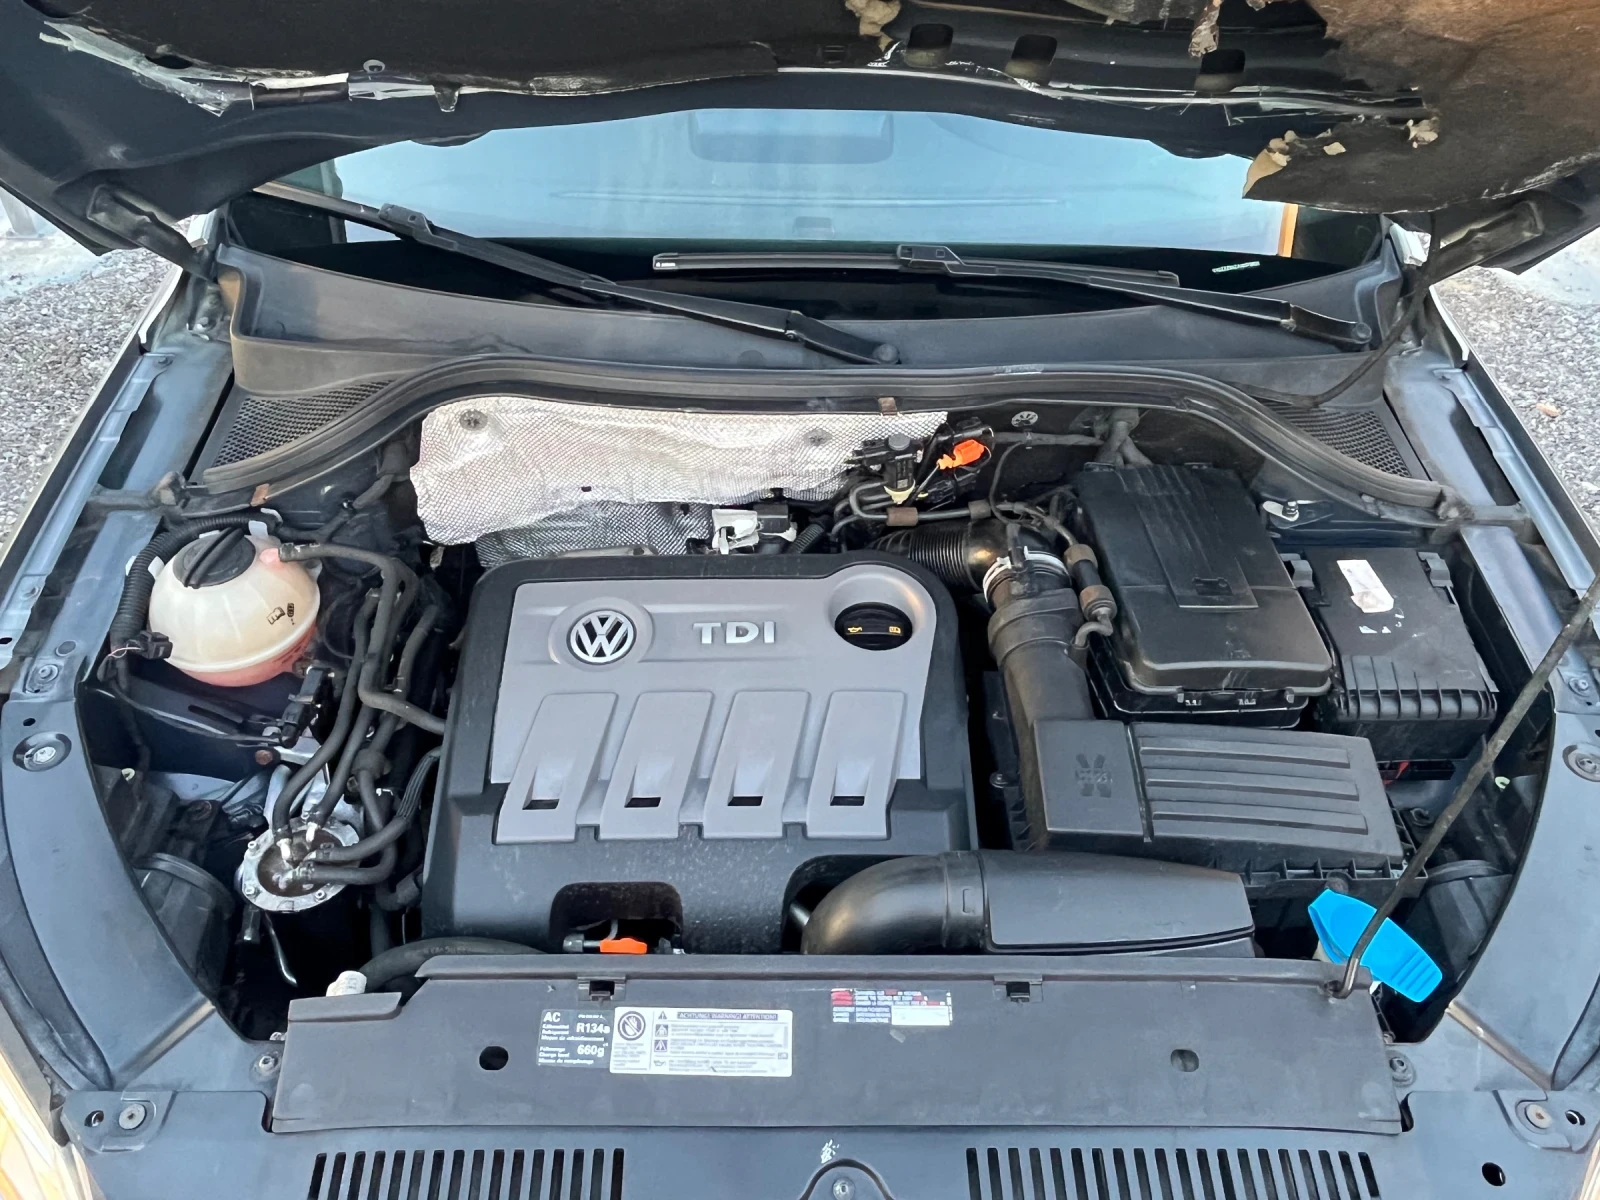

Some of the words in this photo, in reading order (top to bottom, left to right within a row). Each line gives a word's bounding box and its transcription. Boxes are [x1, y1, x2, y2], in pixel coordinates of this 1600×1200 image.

[693, 621, 776, 644] TDI
[543, 1012, 561, 1022] AC
[576, 1022, 611, 1034] R134a
[577, 1044, 605, 1057] 660g
